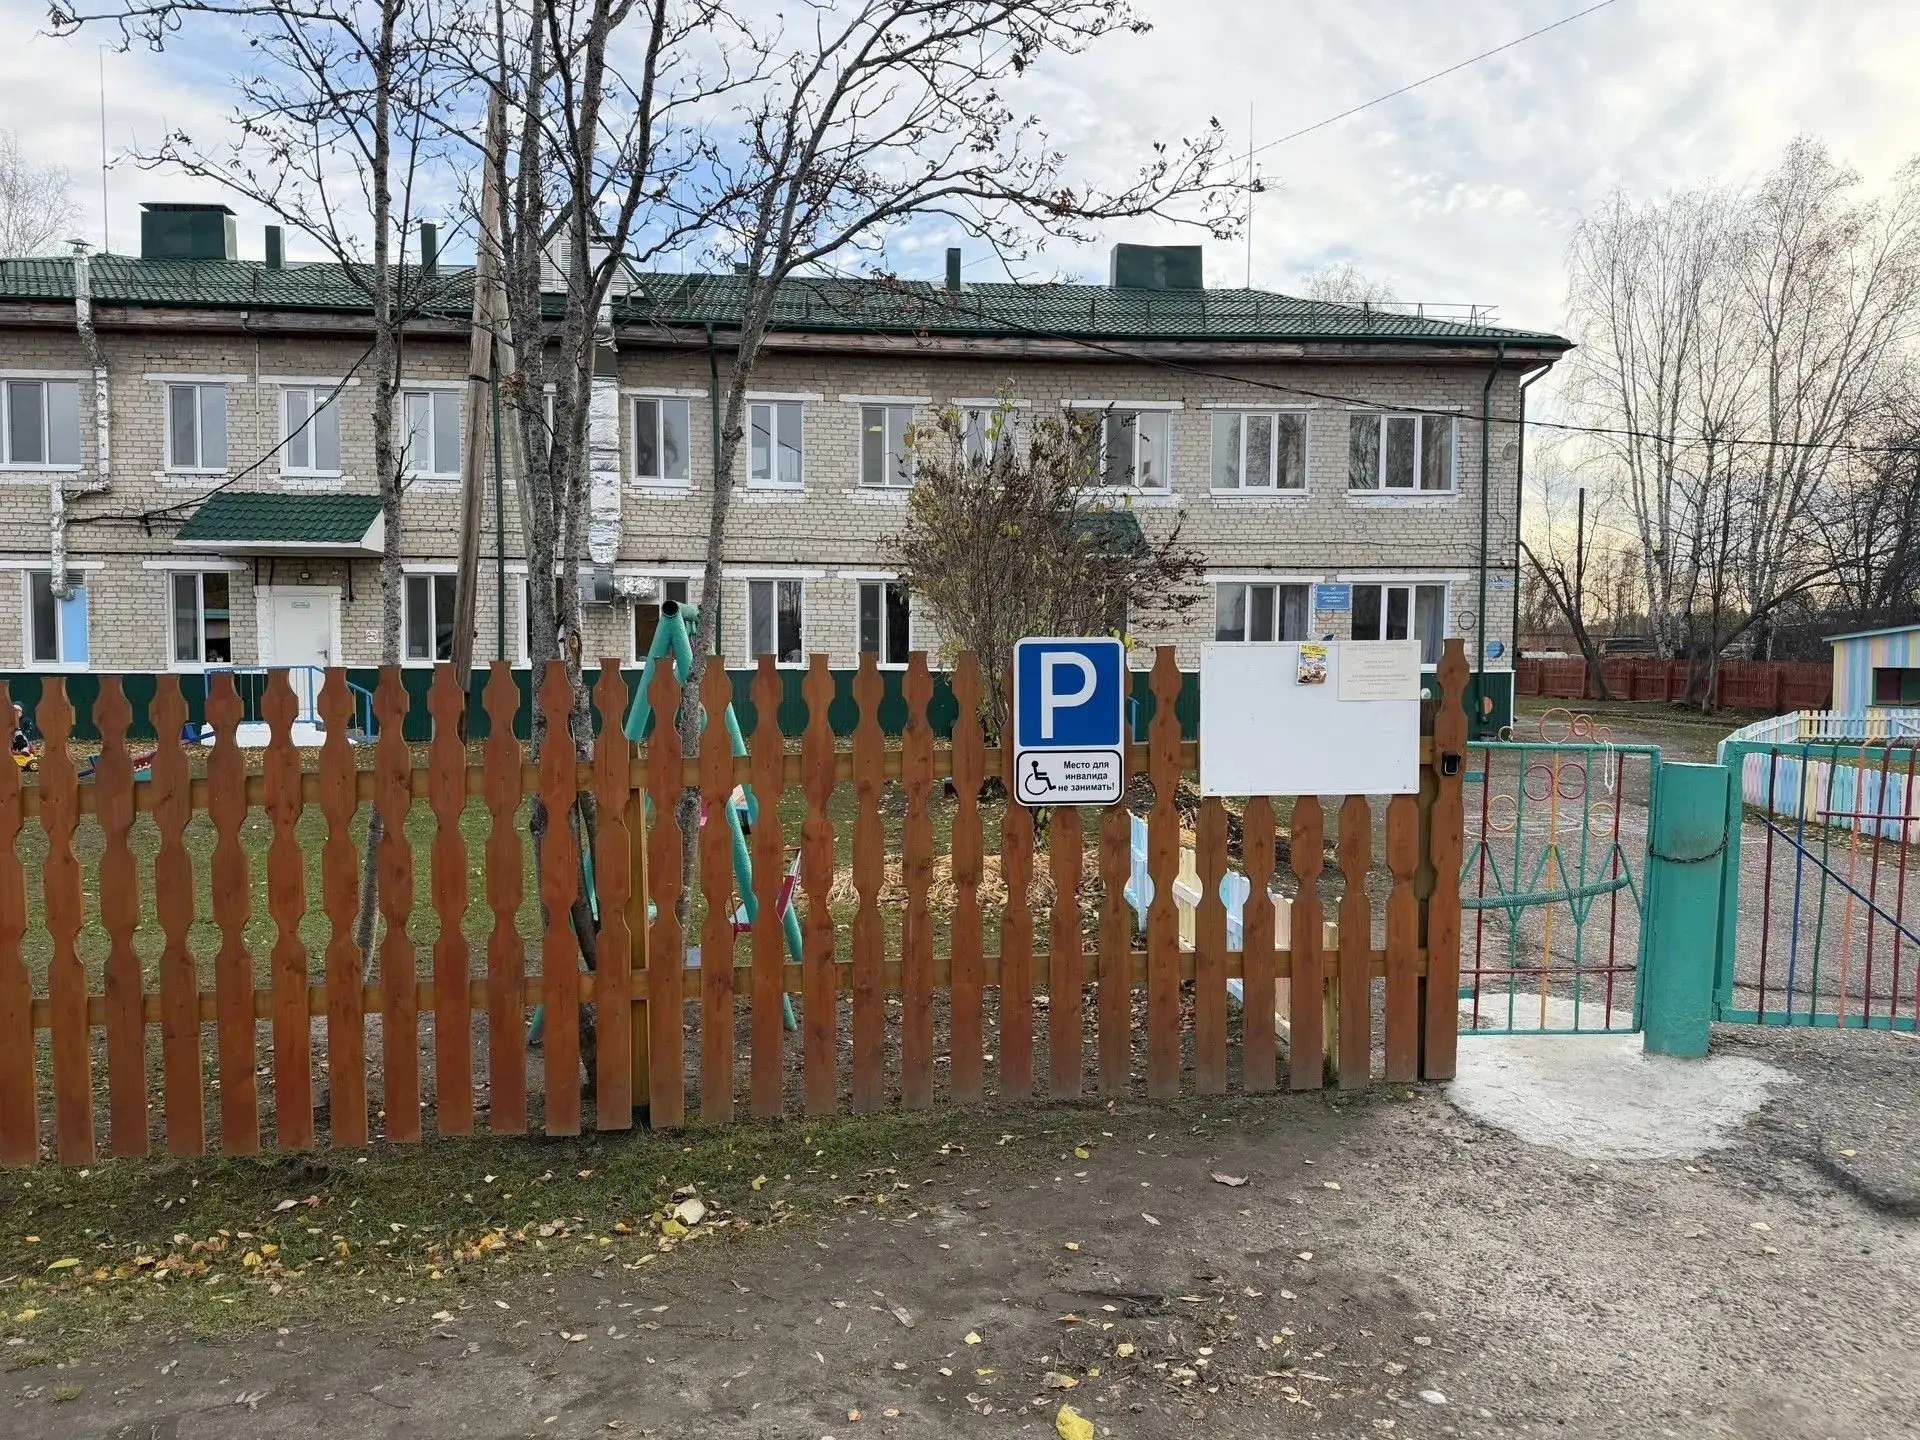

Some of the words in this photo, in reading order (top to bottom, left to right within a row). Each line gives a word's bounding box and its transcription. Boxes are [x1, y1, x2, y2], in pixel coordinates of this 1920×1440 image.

[1040, 651, 1097, 739] P
[1063, 760, 1091, 769] Место
[1092, 761, 1109, 769] для
[1065, 772, 1108, 780] инвалида
[1070, 782, 1115, 791] занимать!
